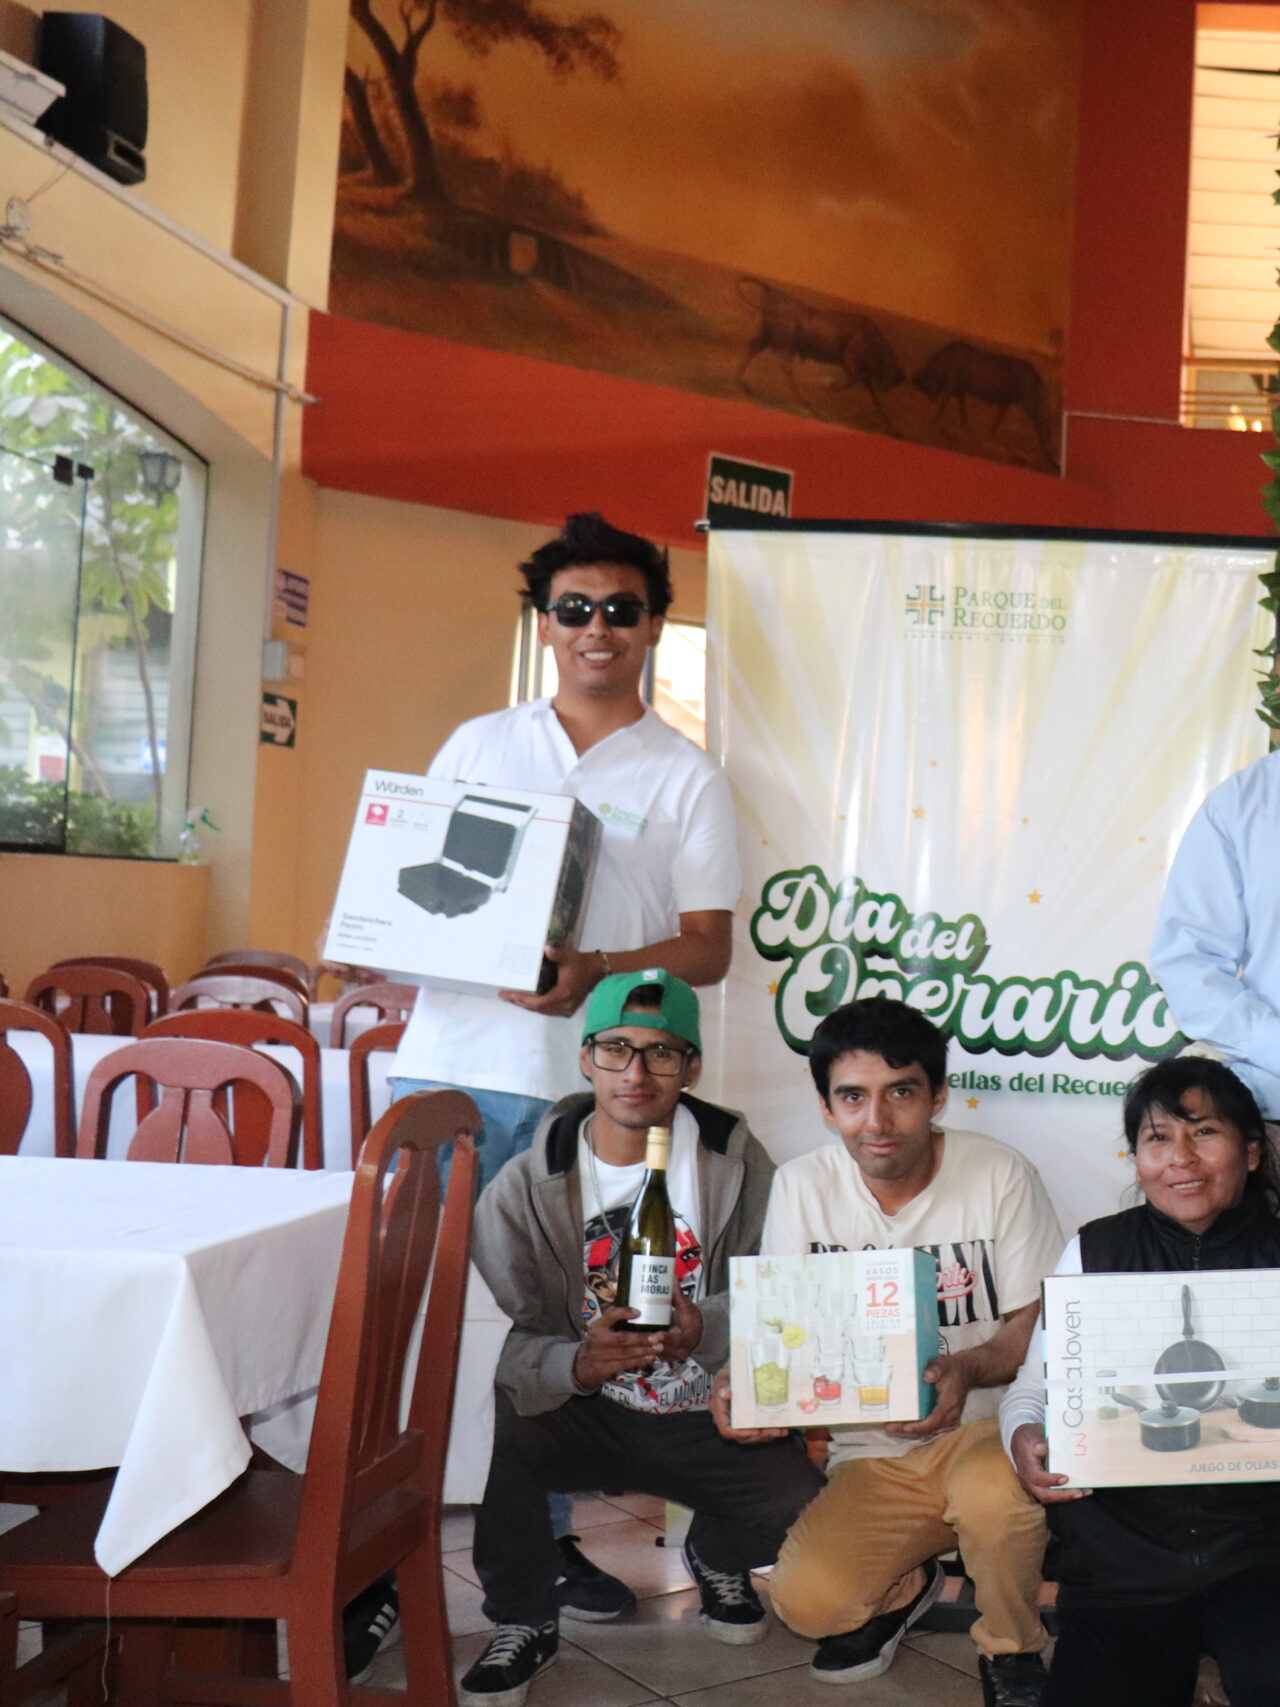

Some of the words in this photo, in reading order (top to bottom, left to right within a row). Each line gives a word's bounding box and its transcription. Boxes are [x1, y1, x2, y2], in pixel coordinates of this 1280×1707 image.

[710, 475, 786, 517] SALIDA
[954, 586, 1036, 611] PARQUE
[1040, 598, 1067, 610] DEL
[953, 607, 1067, 631] RECUERDO
[900, 912, 974, 961] del
[948, 1070, 1002, 1092] ellas
[1009, 1072, 1045, 1093] del
[865, 1266, 898, 1275] VASOS
[865, 1281, 900, 1308] 12
[865, 1308, 901, 1318] PIEZAS
[674, 1372, 713, 1403] MUNDIA
[1188, 1462, 1225, 1473] JUEGO
[1228, 1462, 1242, 1471] DE
[1245, 1460, 1278, 1471] OLLAS
